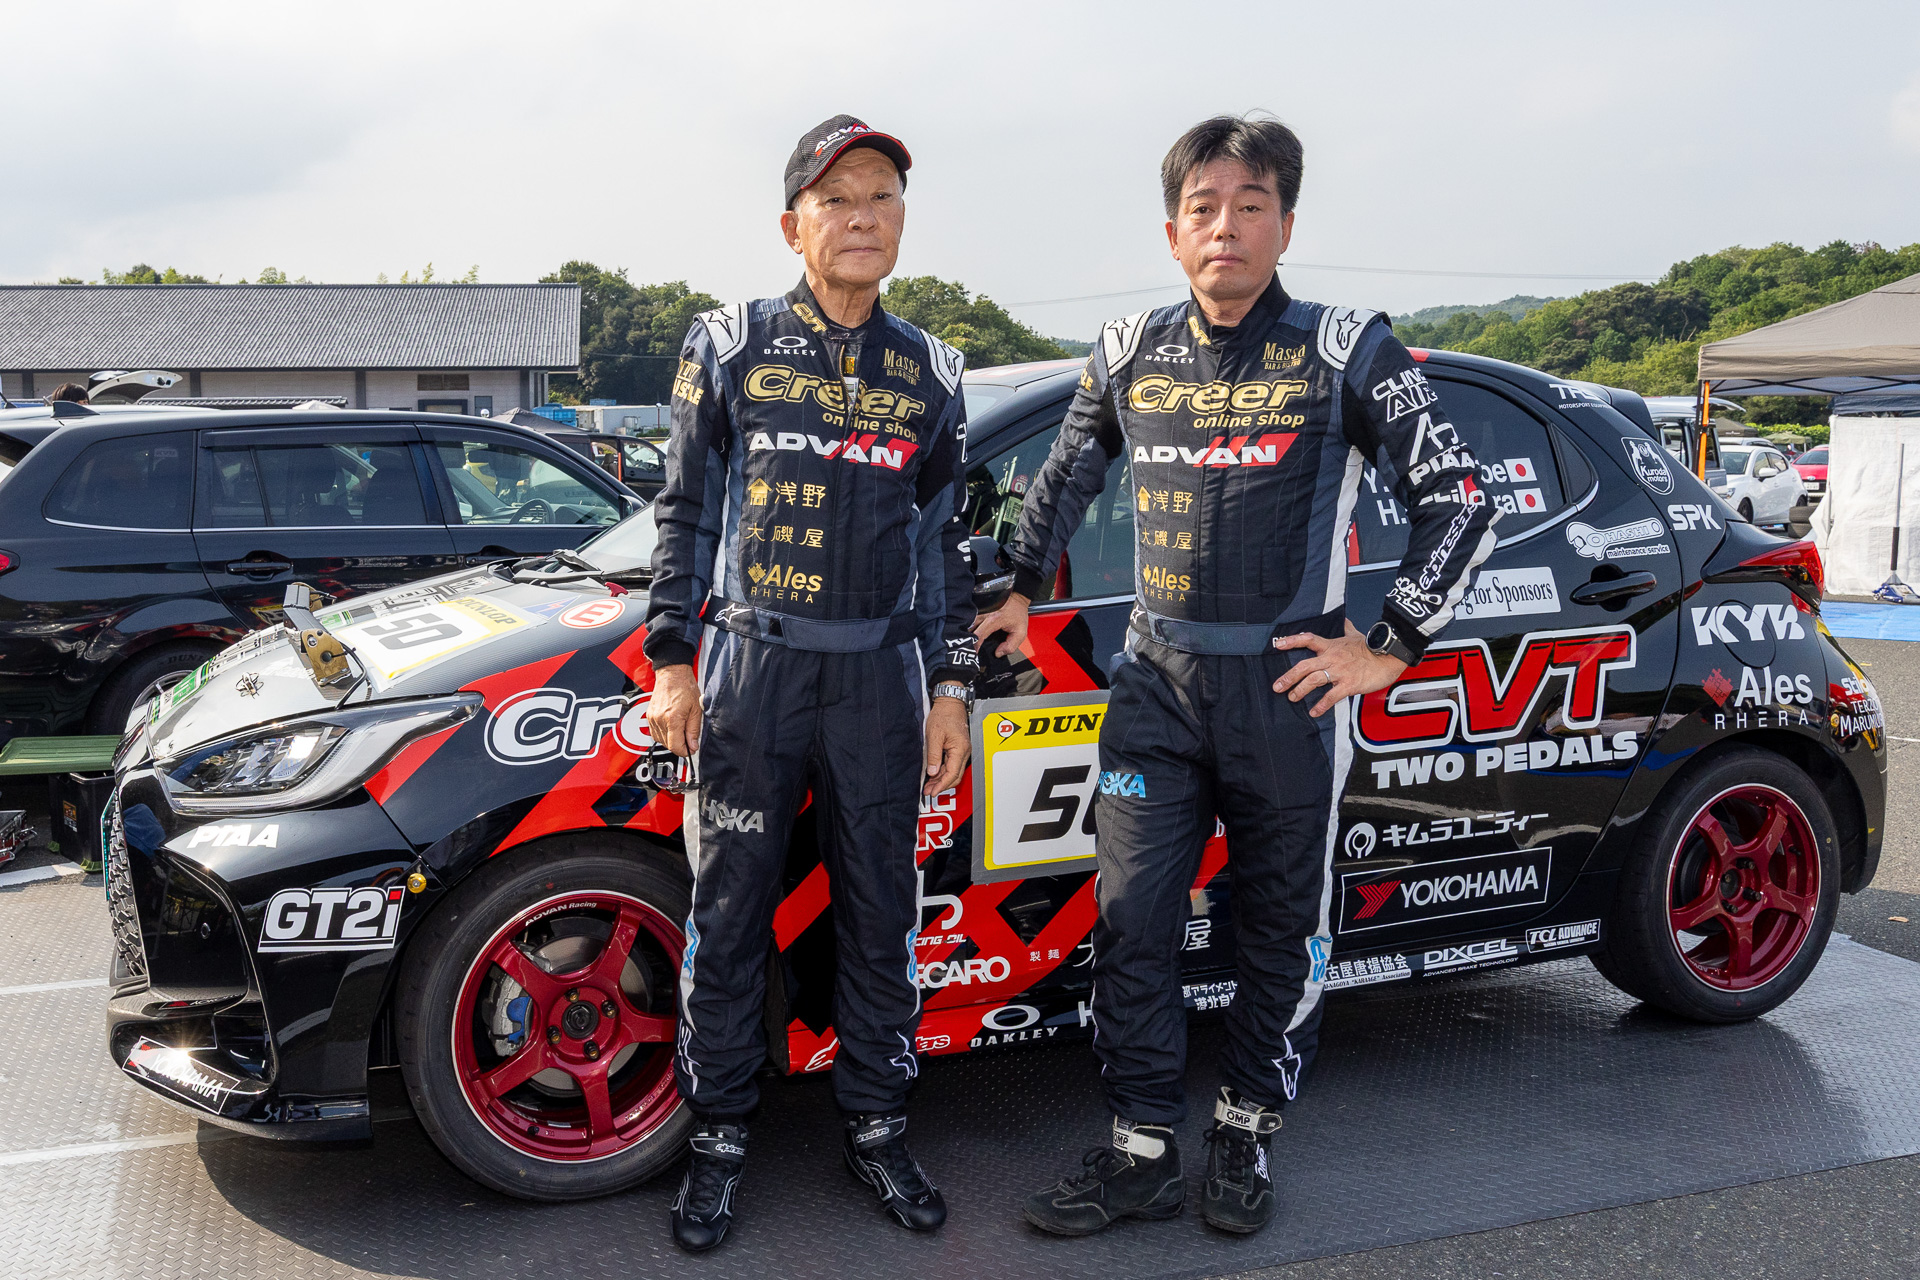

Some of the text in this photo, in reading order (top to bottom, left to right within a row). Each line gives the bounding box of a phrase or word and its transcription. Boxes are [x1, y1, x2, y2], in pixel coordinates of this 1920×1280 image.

[764, 347, 817, 357] OAKLEY
[884, 348, 920, 378] Massa
[1145, 354, 1195, 364] OAKLEY
[1262, 342, 1306, 360] Massa
[1128, 374, 1308, 414] Creer
[884, 422, 918, 443] shop
[1193, 413, 1305, 429] online shop
[749, 431, 908, 471] ADVAN
[1133, 445, 1277, 464] ADVAN
[1641, 465, 1667, 477] Kuroda
[774, 481, 826, 508] 浅野
[1153, 489, 1193, 514] 浅野
[1667, 504, 1721, 530] SPK
[745, 522, 824, 548] 大磯屋
[1141, 527, 1192, 550] 大磯屋
[1607, 544, 1669, 558] maintenance service
[763, 564, 823, 592] Ales
[1150, 565, 1191, 591] Ales
[1491, 576, 1553, 612] Sponsors
[1691, 604, 1805, 646] KYB
[1353, 624, 1637, 753] CVT
[1734, 666, 1813, 707] Ales
[1371, 731, 1639, 789] TWO PEDALS
[187, 824, 280, 849] PIAA
[1382, 811, 1549, 847] キムラユニティー
[1400, 865, 1539, 908] YOKOHAMA
[265, 890, 401, 939] GT2i
[525, 901, 598, 926] ADVAN Racing
[1558, 922, 1598, 940] ADVANCE
[1424, 938, 1517, 970] DIXCEL
[970, 1026, 1058, 1048] OAKLEY
[1226, 1111, 1251, 1125] OMP
